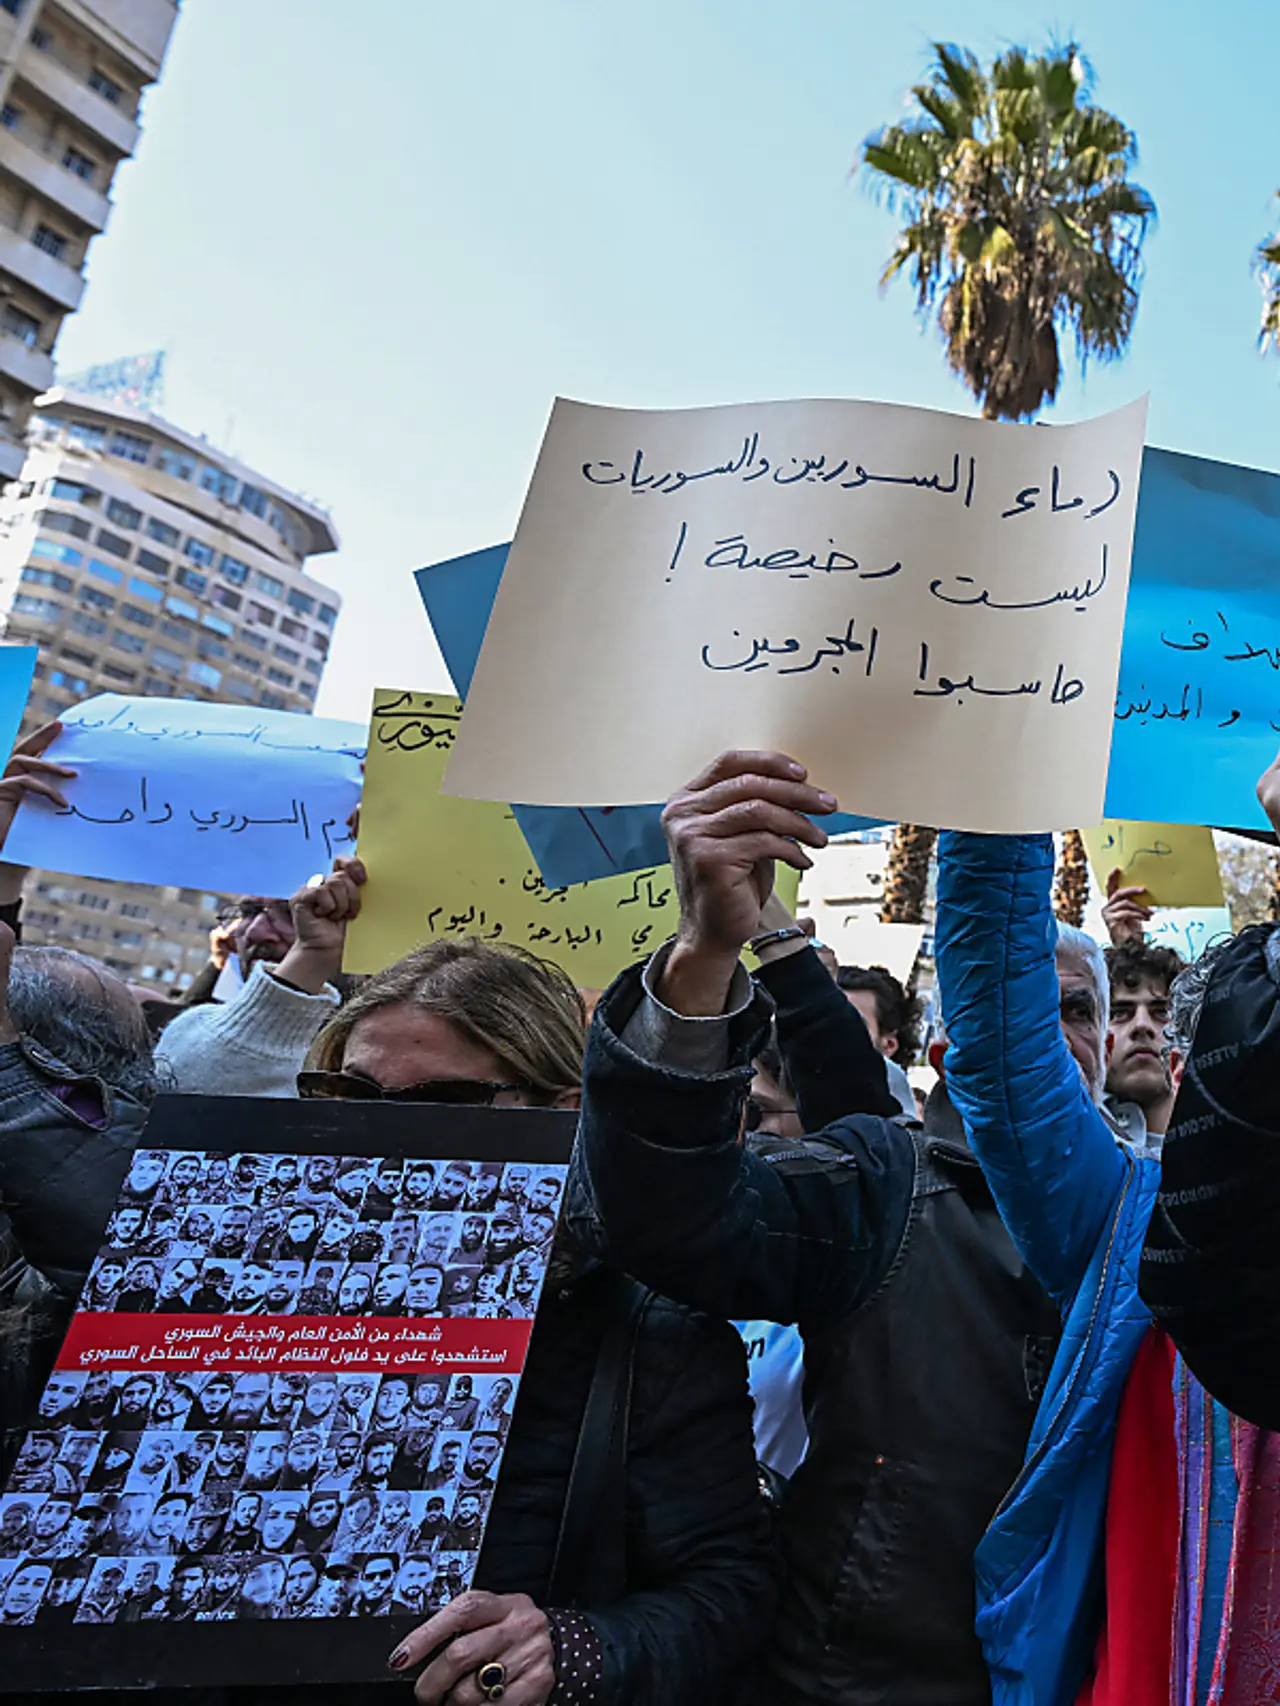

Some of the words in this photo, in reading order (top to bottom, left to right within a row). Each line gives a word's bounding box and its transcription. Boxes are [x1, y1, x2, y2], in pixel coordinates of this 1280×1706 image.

[704, 535, 902, 580] رخيصة
[929, 543, 1109, 612] ليست
[701, 619, 878, 676] المجرمين
[55, 776, 173, 823] واحد
[428, 906, 503, 938] واليوم
[164, 1325, 222, 1344] السوري
[224, 1322, 285, 1342] والجيش
[288, 1326, 327, 1342] العام
[329, 1321, 367, 1342] الأمن
[369, 1328, 390, 1342] من
[393, 1324, 442, 1342] شهداء
[79, 1345, 139, 1366] السوري
[141, 1346, 200, 1363] الساحل
[203, 1348, 232, 1366] في
[235, 1348, 277, 1360] البائد
[278, 1347, 329, 1364] النظام
[331, 1347, 369, 1365] فلول
[372, 1350, 391, 1365] يد
[394, 1349, 427, 1364] على
[431, 1346, 508, 1365] استشهدوا
